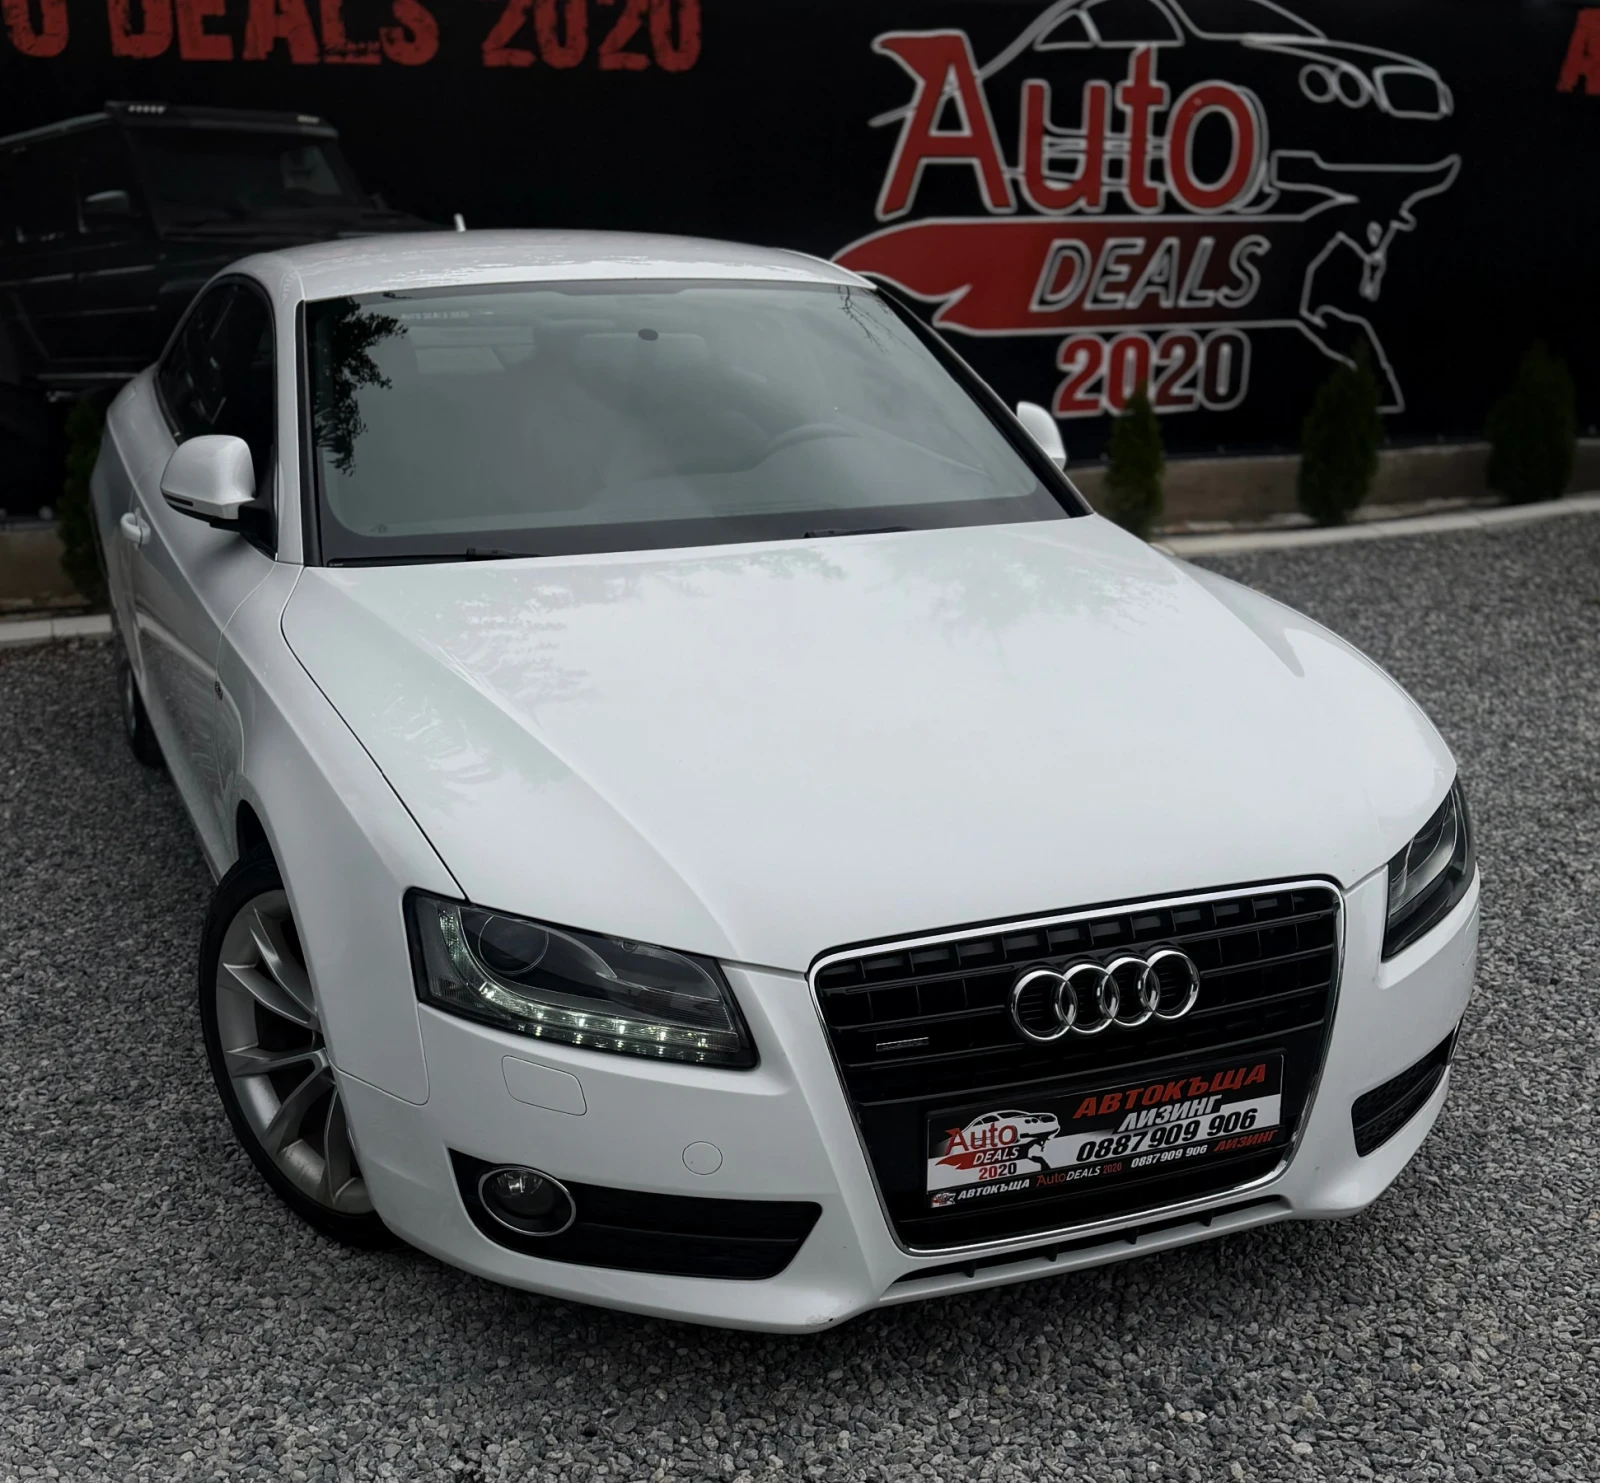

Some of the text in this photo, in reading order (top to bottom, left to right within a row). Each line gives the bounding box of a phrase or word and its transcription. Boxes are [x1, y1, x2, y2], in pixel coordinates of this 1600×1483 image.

[108, 0, 440, 66] DEALS
[481, 0, 702, 72] 2020
[873, 28, 1264, 219] Auto
[1029, 235, 1271, 313] DEALS
[1053, 329, 1251, 418] 2020
[1073, 1064, 1266, 1119] АВТОКЪЩА
[1117, 1095, 1222, 1133] ЛИЗИНГ
[945, 1122, 1018, 1156] Auto
[1207, 1108, 1258, 1137] 906
[957, 1179, 1030, 1200] АВТОКЪЩА
[1103, 1162, 1122, 1174] 2020
[1185, 1145, 1208, 1156] 906
[1213, 1130, 1278, 1153] ЛИЗИНГ
[973, 1147, 1020, 1165] DEALS
[978, 1162, 1017, 1181] 2020
